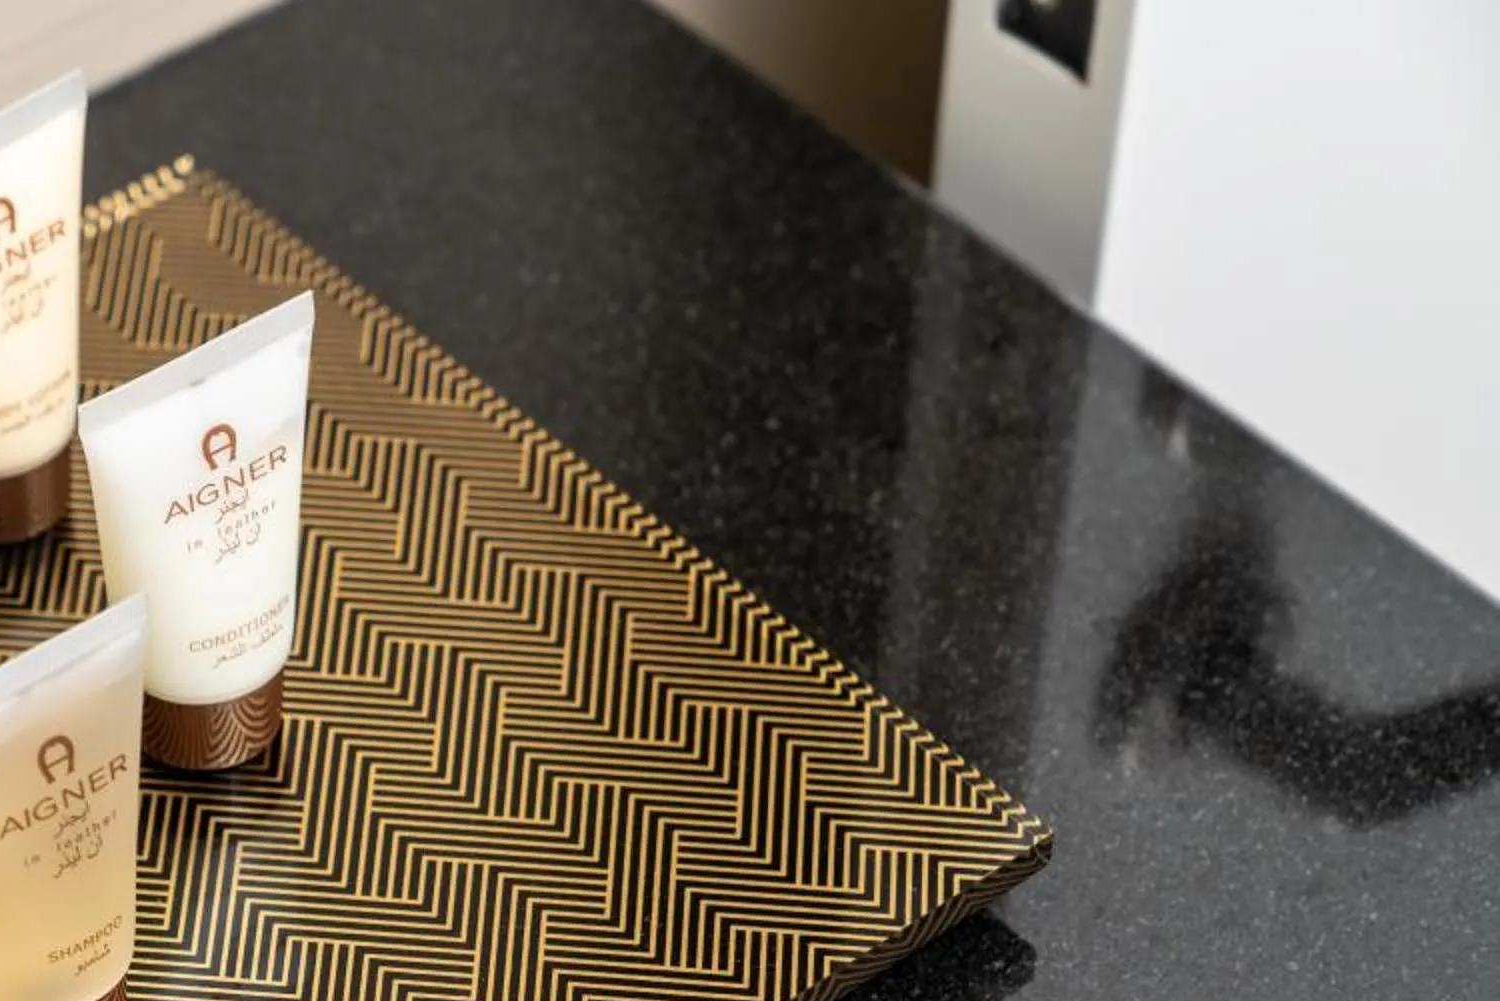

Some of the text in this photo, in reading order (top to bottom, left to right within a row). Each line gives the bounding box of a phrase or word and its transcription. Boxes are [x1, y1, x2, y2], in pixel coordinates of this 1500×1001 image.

[164, 445, 288, 524] AIGNER
[0, 754, 128, 840] AIGNER
[48, 915, 123, 963] SHAMPOO
